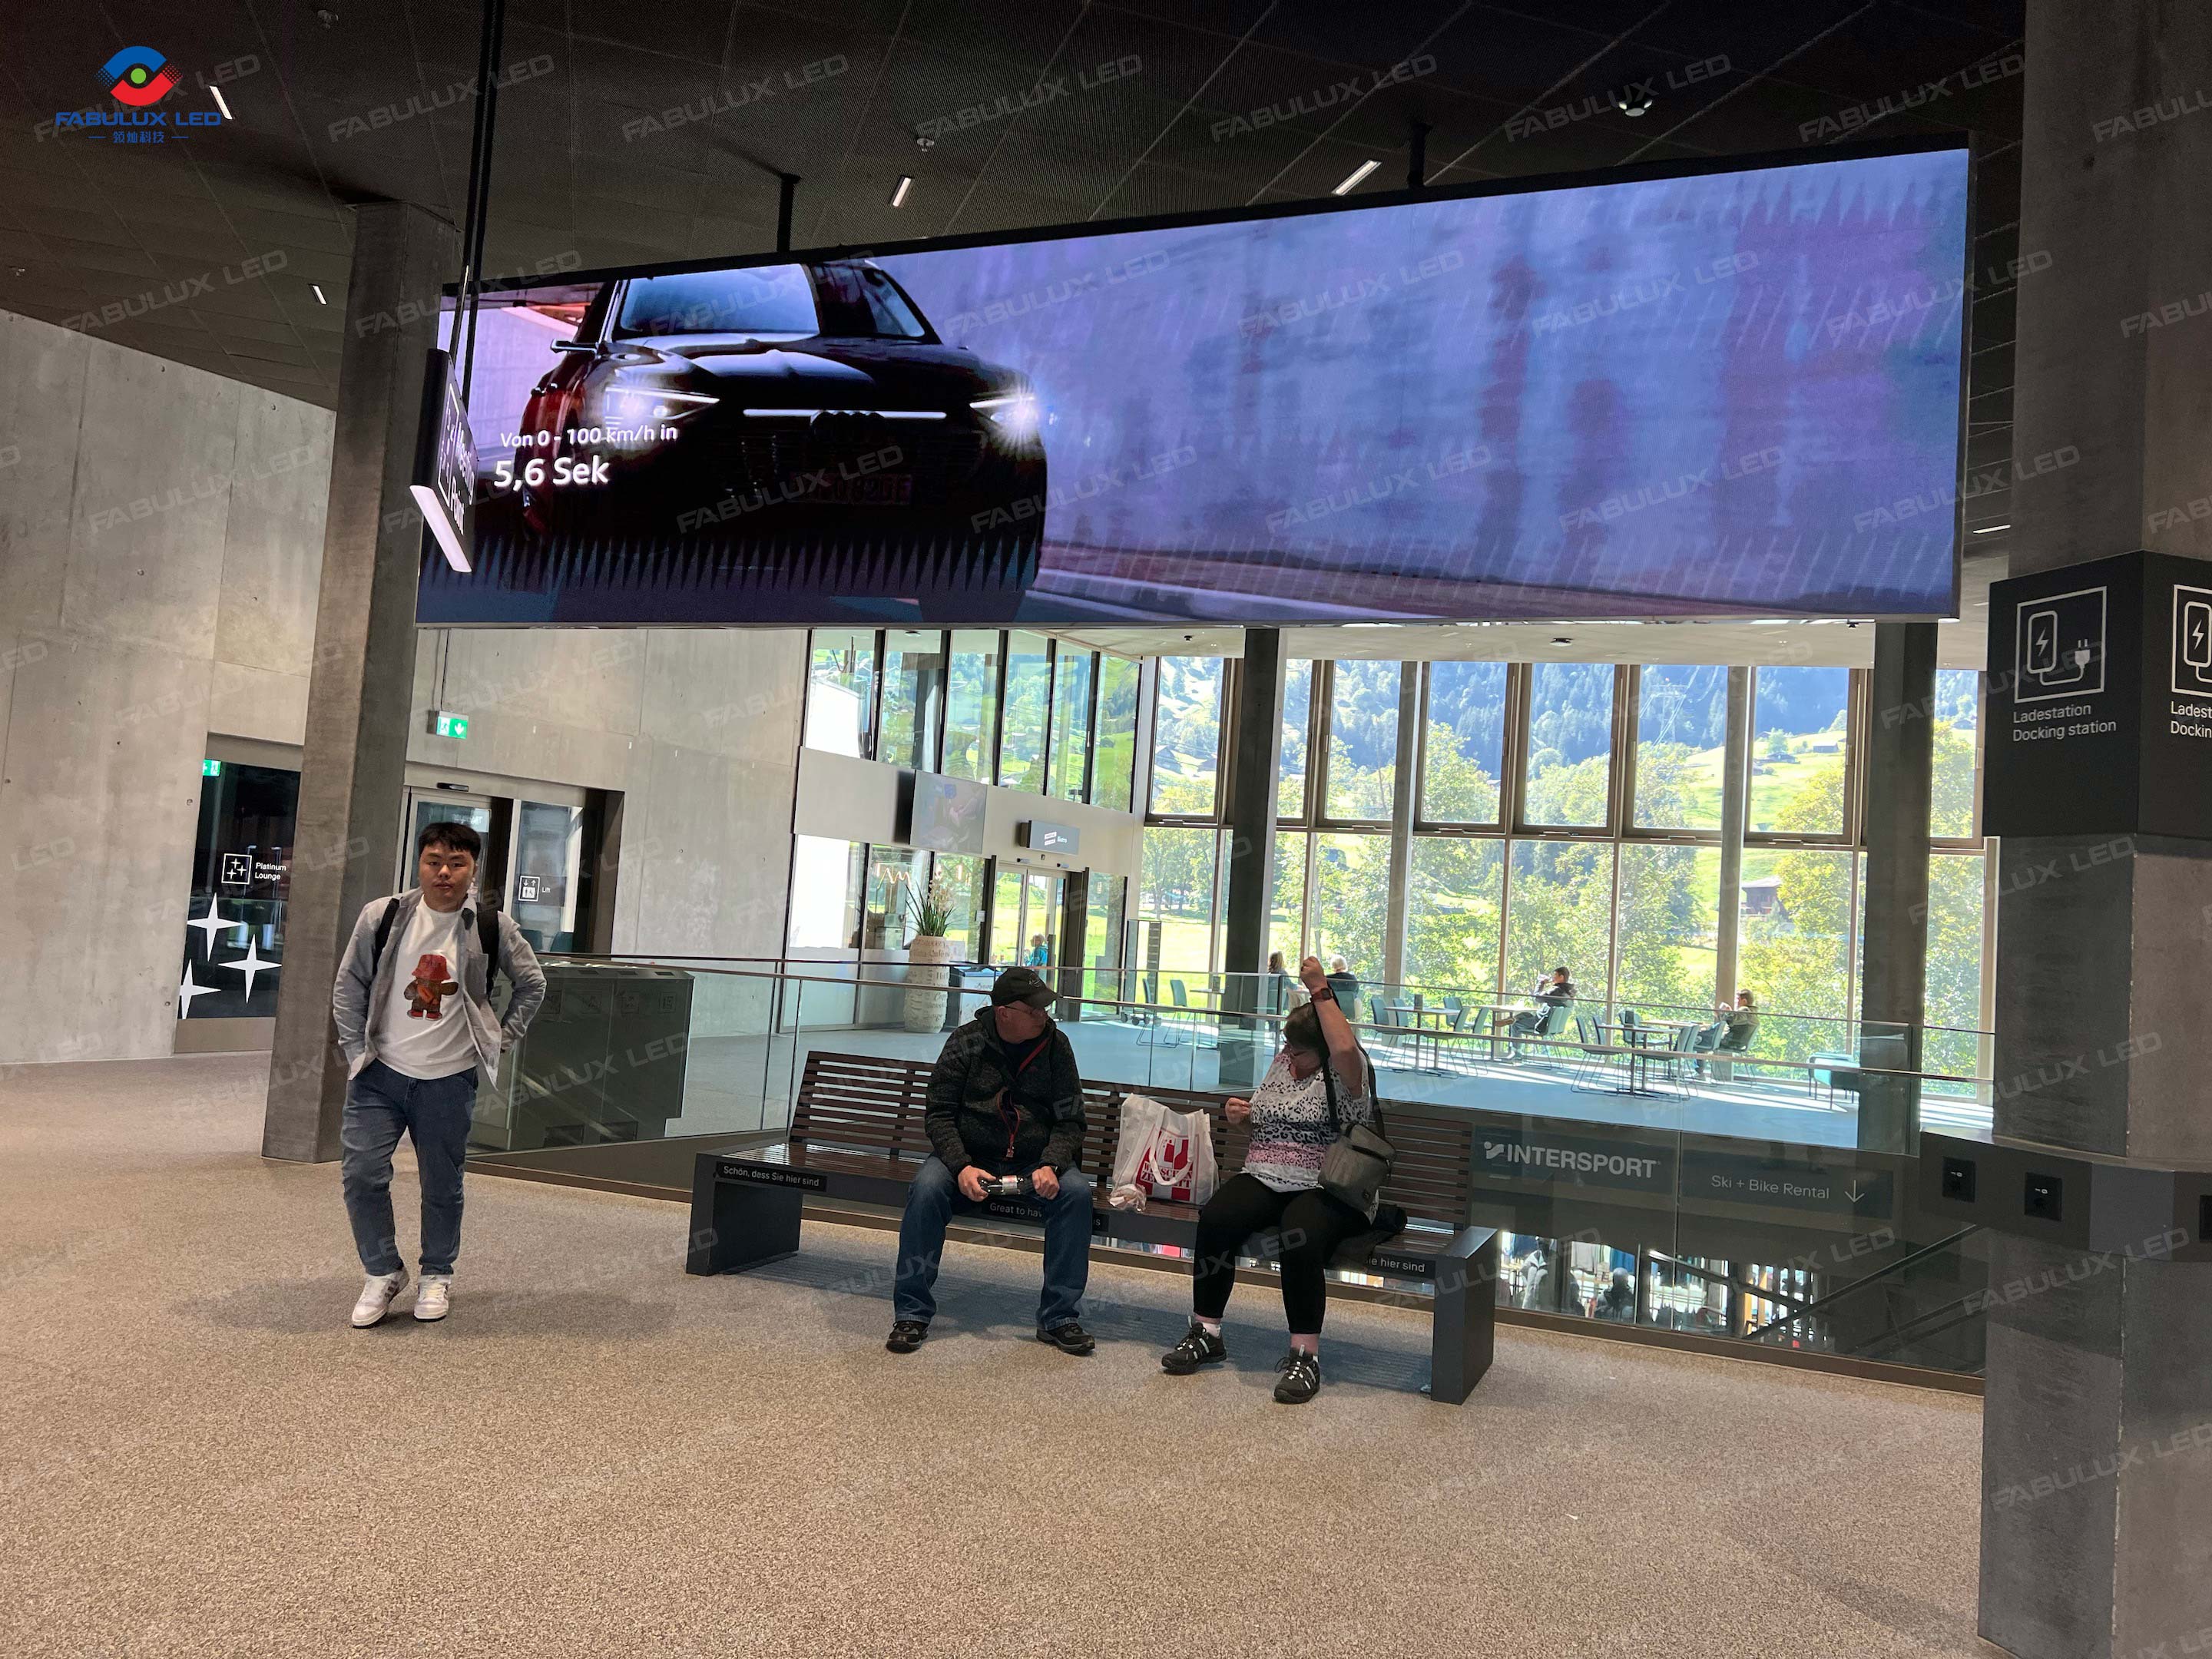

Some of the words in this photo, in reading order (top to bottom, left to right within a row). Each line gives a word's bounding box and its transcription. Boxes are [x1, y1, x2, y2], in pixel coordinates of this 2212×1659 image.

[500, 432, 533, 448] Von
[537, 430, 548, 445] 0
[567, 428, 602, 445] 100
[606, 425, 654, 444] km/h
[660, 423, 678, 441] in
[494, 458, 545, 492] 5,6
[552, 455, 611, 486] Sek
[2013, 704, 2091, 724] Ladestation
[2012, 724, 2065, 742] Docking
[2068, 719, 2117, 737] station
[2171, 720, 2212, 738] Dockin
[254, 872, 281, 881] Lounge
[255, 862, 287, 871] Platinum
[1507, 1144, 1657, 1179] INTERSPORT
[724, 1166, 750, 1177] Schön,
[751, 1171, 770, 1180] dass
[771, 1172, 784, 1182] Sie
[786, 1174, 800, 1184] hier
[802, 1178, 820, 1187] sind
[1711, 1175, 1733, 1188] Ski
[1749, 1178, 1779, 1194] Bike
[1783, 1184, 1830, 1199] Rental
[990, 1203, 1014, 1214] Great
[1016, 1205, 1025, 1216] to
[1028, 1207, 1042, 1217] hav
[1380, 1258, 1399, 1270] hier
[1402, 1260, 1426, 1273] sind
